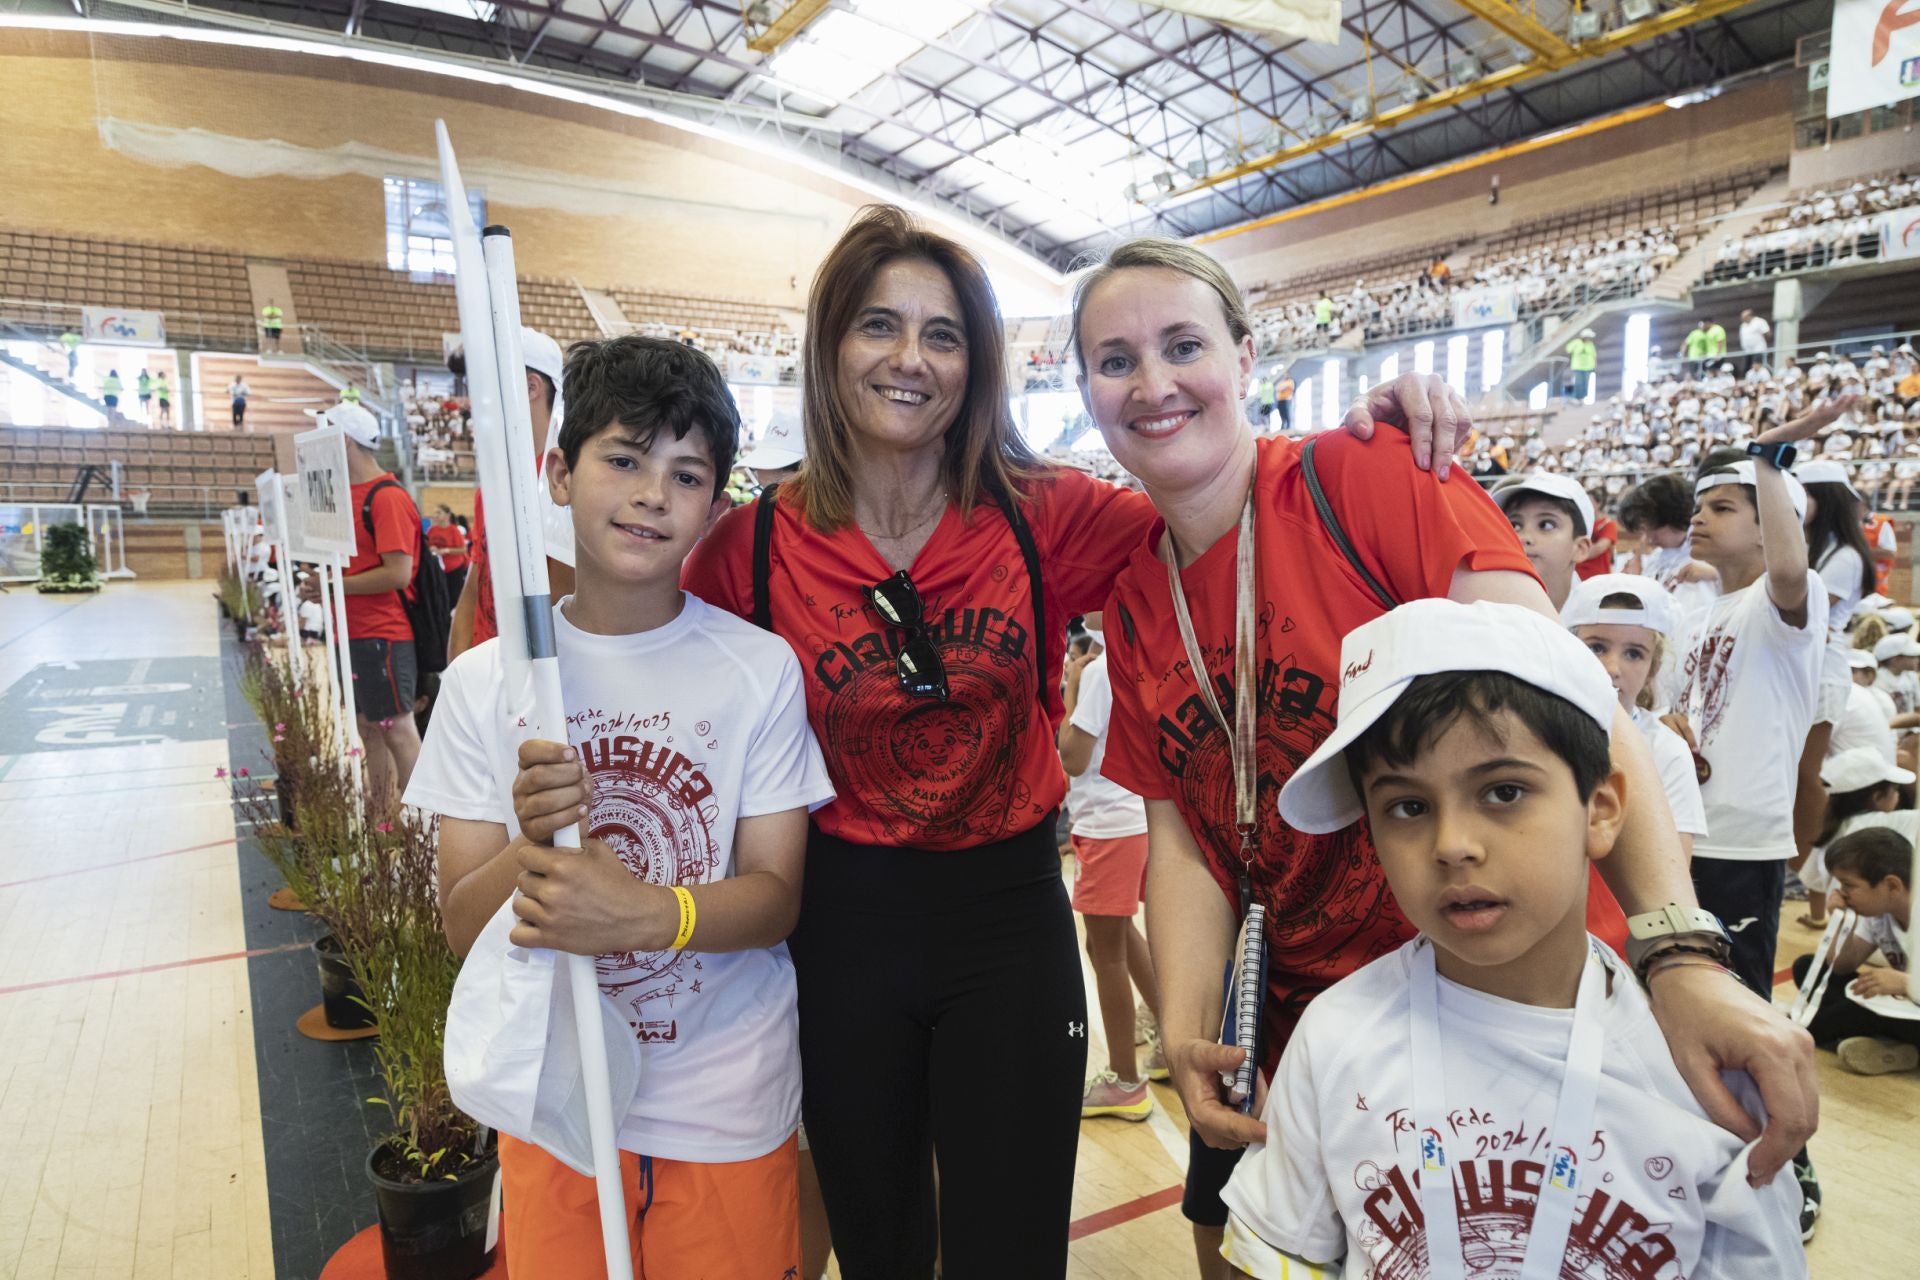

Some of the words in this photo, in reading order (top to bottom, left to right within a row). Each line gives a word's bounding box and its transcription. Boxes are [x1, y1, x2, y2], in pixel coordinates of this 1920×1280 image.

[814, 606, 1028, 694] Claura
[591, 711, 671, 740] 2024/2025
[573, 735, 713, 809] usura
[589, 812, 645, 829] PORTIVAS
[645, 829, 663, 885] MUNICIPA
[1475, 1119, 1606, 1161] 2024/5
[1363, 1159, 1676, 1280] Clusra
